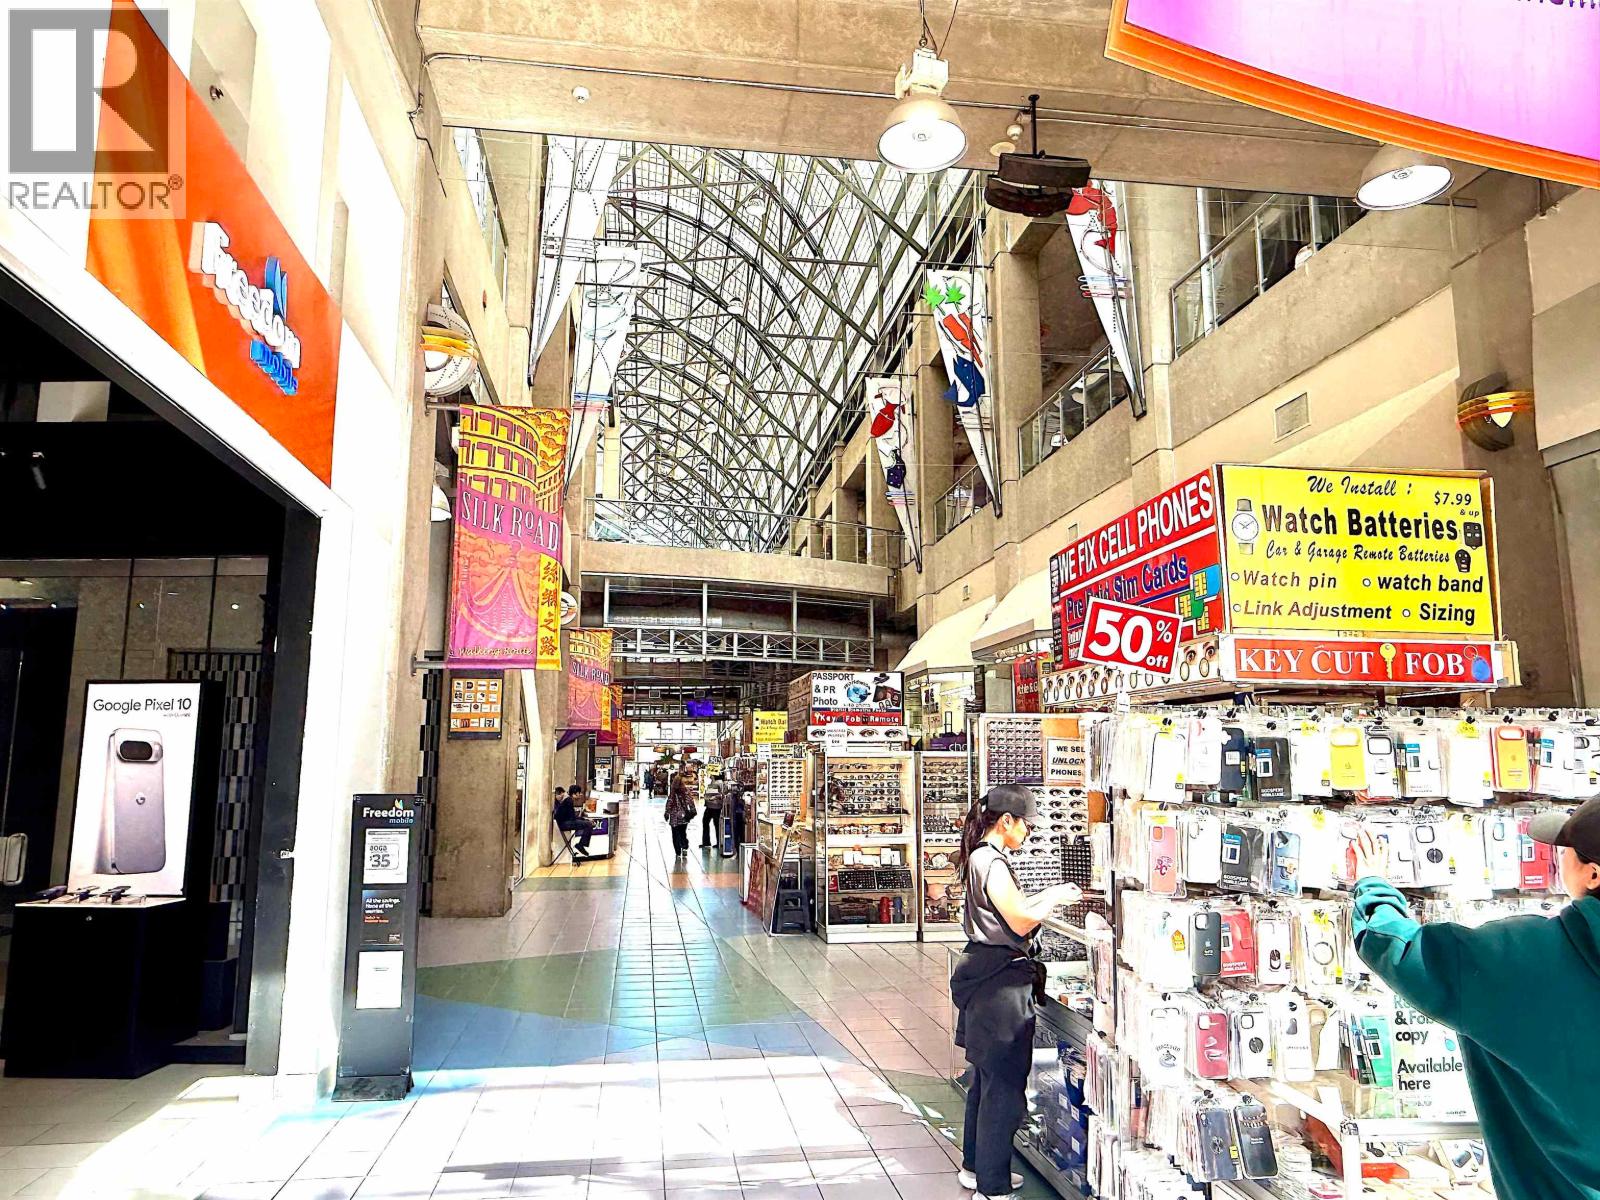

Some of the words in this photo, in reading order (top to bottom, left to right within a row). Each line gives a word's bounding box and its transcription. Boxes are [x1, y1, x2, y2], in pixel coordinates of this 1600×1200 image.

[193, 221, 302, 369] Freedom
[1307, 475, 1334, 493] We
[1341, 475, 1397, 496] Install
[1434, 490, 1472, 506] $7.99
[461, 489, 505, 535] SILK
[1058, 548, 1077, 586] WE
[1077, 535, 1098, 577] FIX
[1099, 518, 1137, 566] CELL
[1137, 475, 1215, 549] PHONES
[1261, 504, 1338, 535] Watch
[1347, 508, 1459, 541] Batteries
[1266, 540, 1287, 559] Car
[1294, 541, 1302, 556] &
[1308, 541, 1348, 564] Garage
[1353, 544, 1394, 561] Remote
[1399, 545, 1450, 563] Batteries
[1065, 595, 1084, 623] Pre
[1113, 575, 1140, 602] Sim
[1142, 552, 1189, 594] Cards
[1243, 569, 1301, 588] Watch
[1308, 573, 1337, 591] pin
[1378, 574, 1432, 591] watch
[1438, 575, 1483, 593] band
[1244, 600, 1284, 616] Link
[1287, 601, 1392, 621] Adjustment
[1419, 603, 1476, 626] Sizing
[572, 661, 589, 680] SILK
[1238, 648, 1304, 674] KEY
[1310, 649, 1374, 676] CUT
[1404, 652, 1465, 676] FOB
[812, 672, 855, 681] PASSPORT
[814, 684, 822, 694] &
[823, 685, 836, 694] PR
[93, 699, 142, 714] Google
[144, 698, 174, 711] Pixel
[177, 698, 192, 711] 10
[812, 696, 838, 706] Photo
[820, 714, 835, 723] Key
[845, 715, 860, 723] Fob
[870, 715, 899, 723] Remote
[362, 807, 414, 818] Freedom
[1395, 1010, 1408, 1025] &
[1395, 1031, 1429, 1045] copy
[1397, 1057, 1464, 1074] Available
[1398, 1075, 1431, 1090] here
